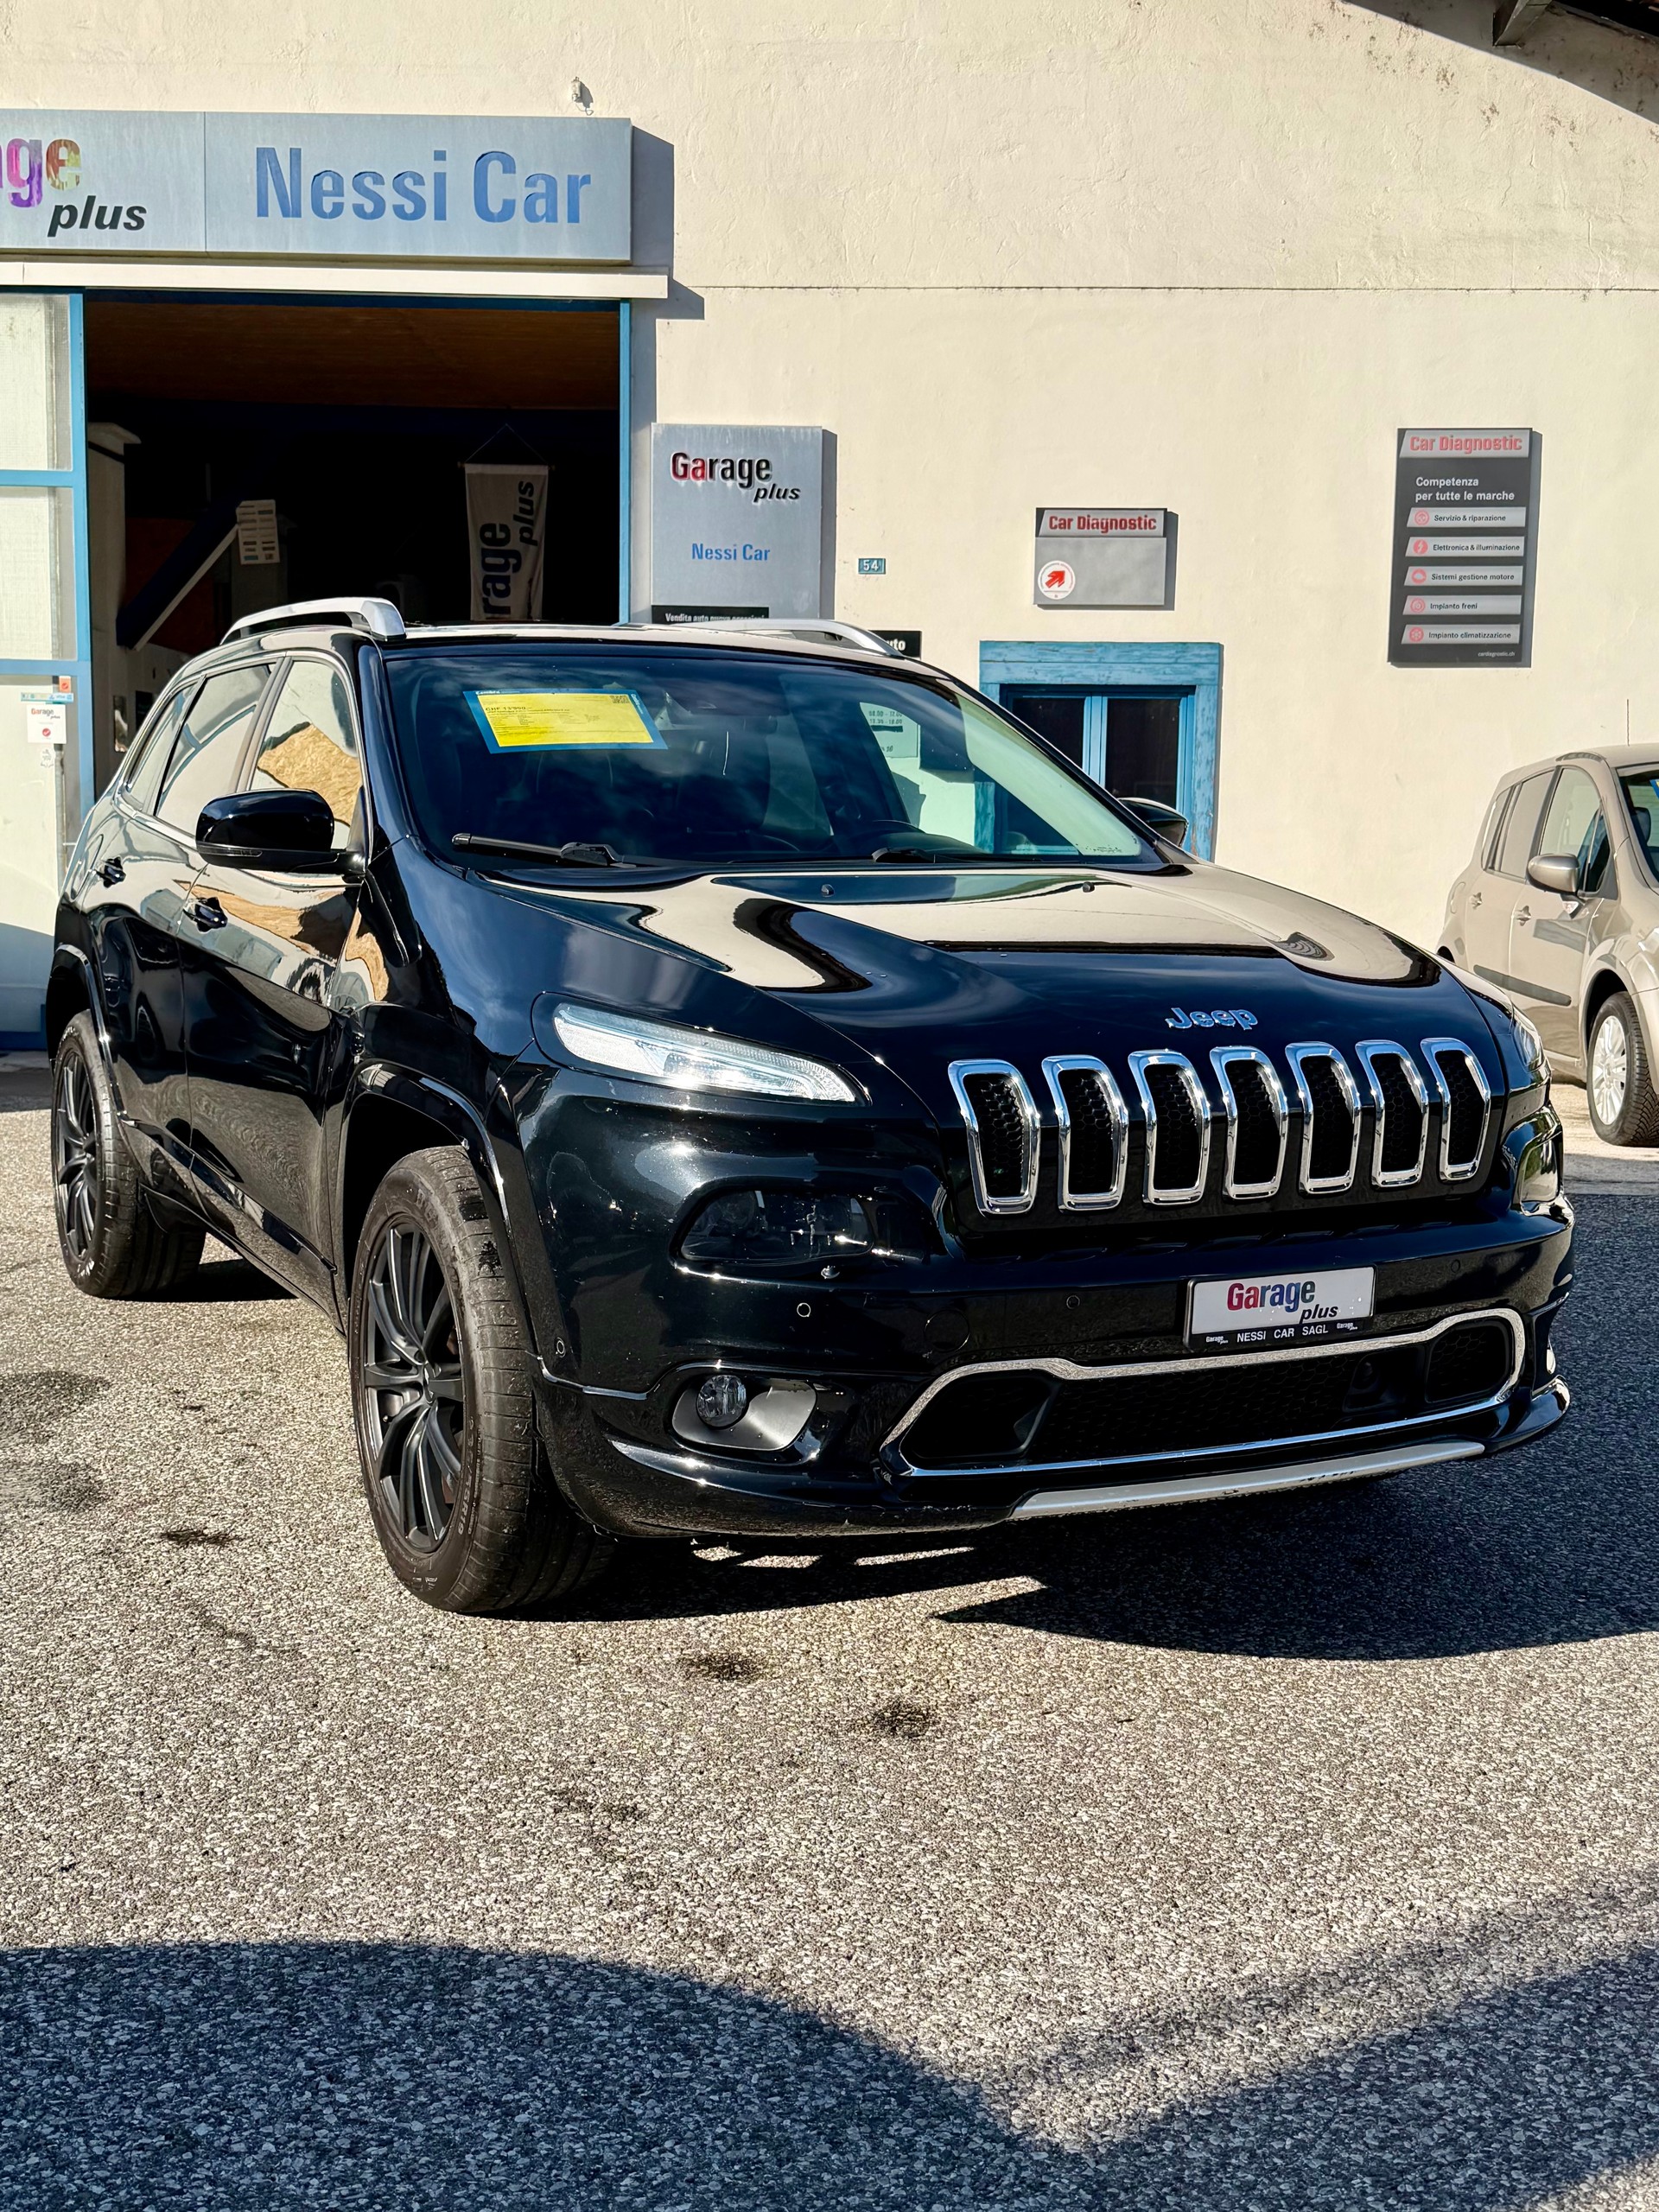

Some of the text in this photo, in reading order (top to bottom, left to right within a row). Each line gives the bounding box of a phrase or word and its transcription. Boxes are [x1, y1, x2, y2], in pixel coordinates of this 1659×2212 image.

[0, 138, 82, 208] ge
[256, 146, 592, 224] Nessi Car
[48, 195, 147, 238] plus
[1409, 435, 1523, 454] Car Diagnostic
[671, 452, 772, 489] Garage
[1415, 476, 1479, 488] Competenza
[753, 483, 802, 503] plus
[1415, 490, 1515, 503] per tutte le marche
[512, 480, 539, 546] plus
[1048, 514, 1157, 534] Car Diagnostic
[691, 543, 771, 562] Nessi Car
[479, 522, 523, 620] rage
[863, 559, 879, 571] 54
[1430, 602, 1460, 611] Impianto
[664, 613, 692, 622] Vendita
[886, 639, 906, 652] uto
[30, 708, 54, 716] Garage
[1165, 1007, 1258, 1031] Jeep
[1226, 1280, 1316, 1313] Garage
[1299, 1304, 1339, 1325] plus
[1205, 1335, 1224, 1344] Garage
[1236, 1324, 1329, 1343] NESSI CAR SAGL
